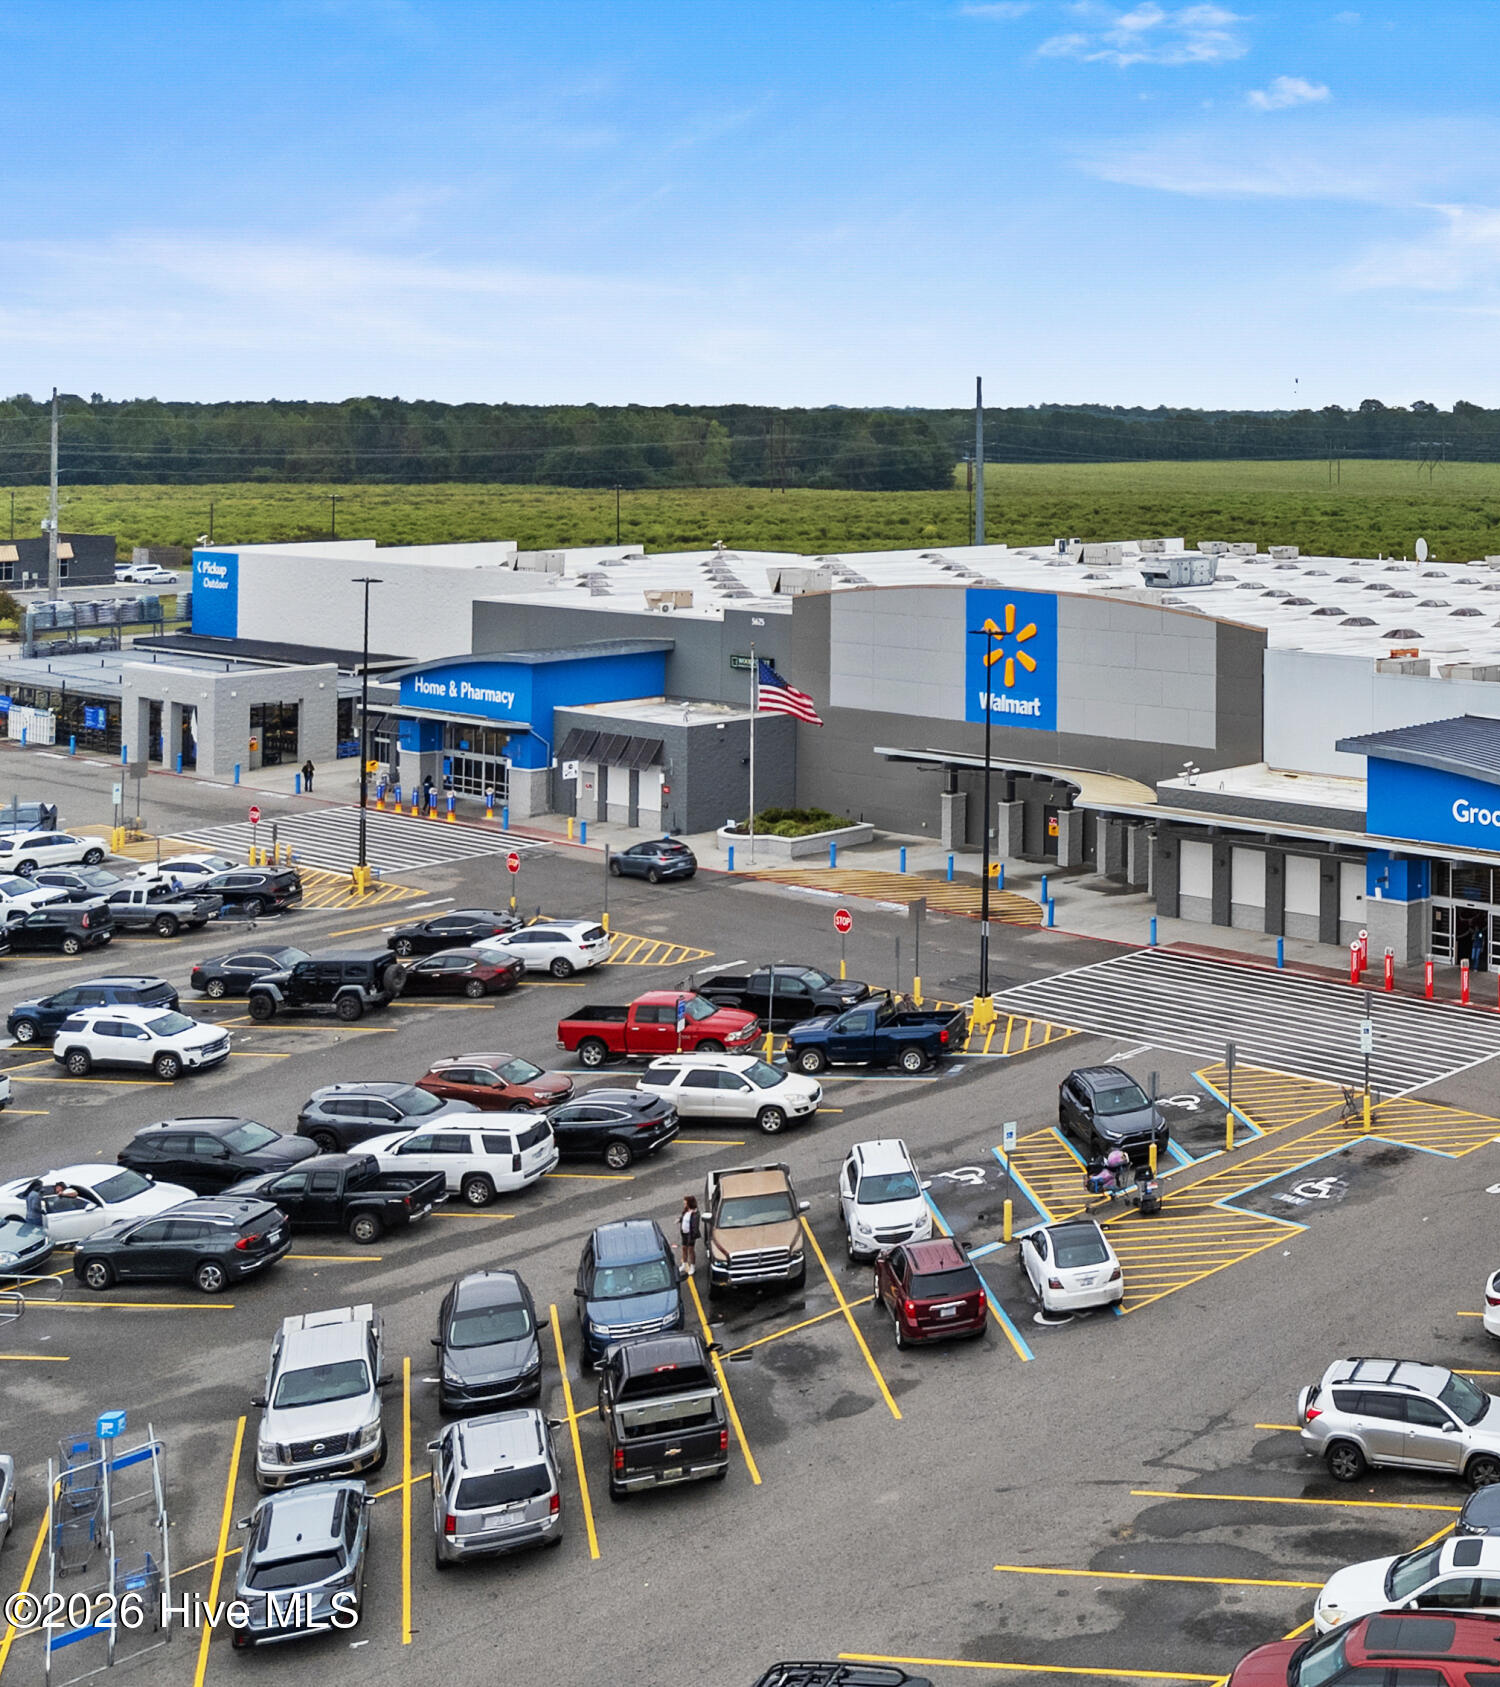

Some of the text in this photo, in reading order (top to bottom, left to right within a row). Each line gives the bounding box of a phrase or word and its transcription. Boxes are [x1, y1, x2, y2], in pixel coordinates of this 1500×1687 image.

[202, 561, 227, 579] Pickup
[414, 676, 515, 710] Home & Pharmacy
[978, 691, 1041, 716] Walmart
[835, 915, 850, 926] STOP
